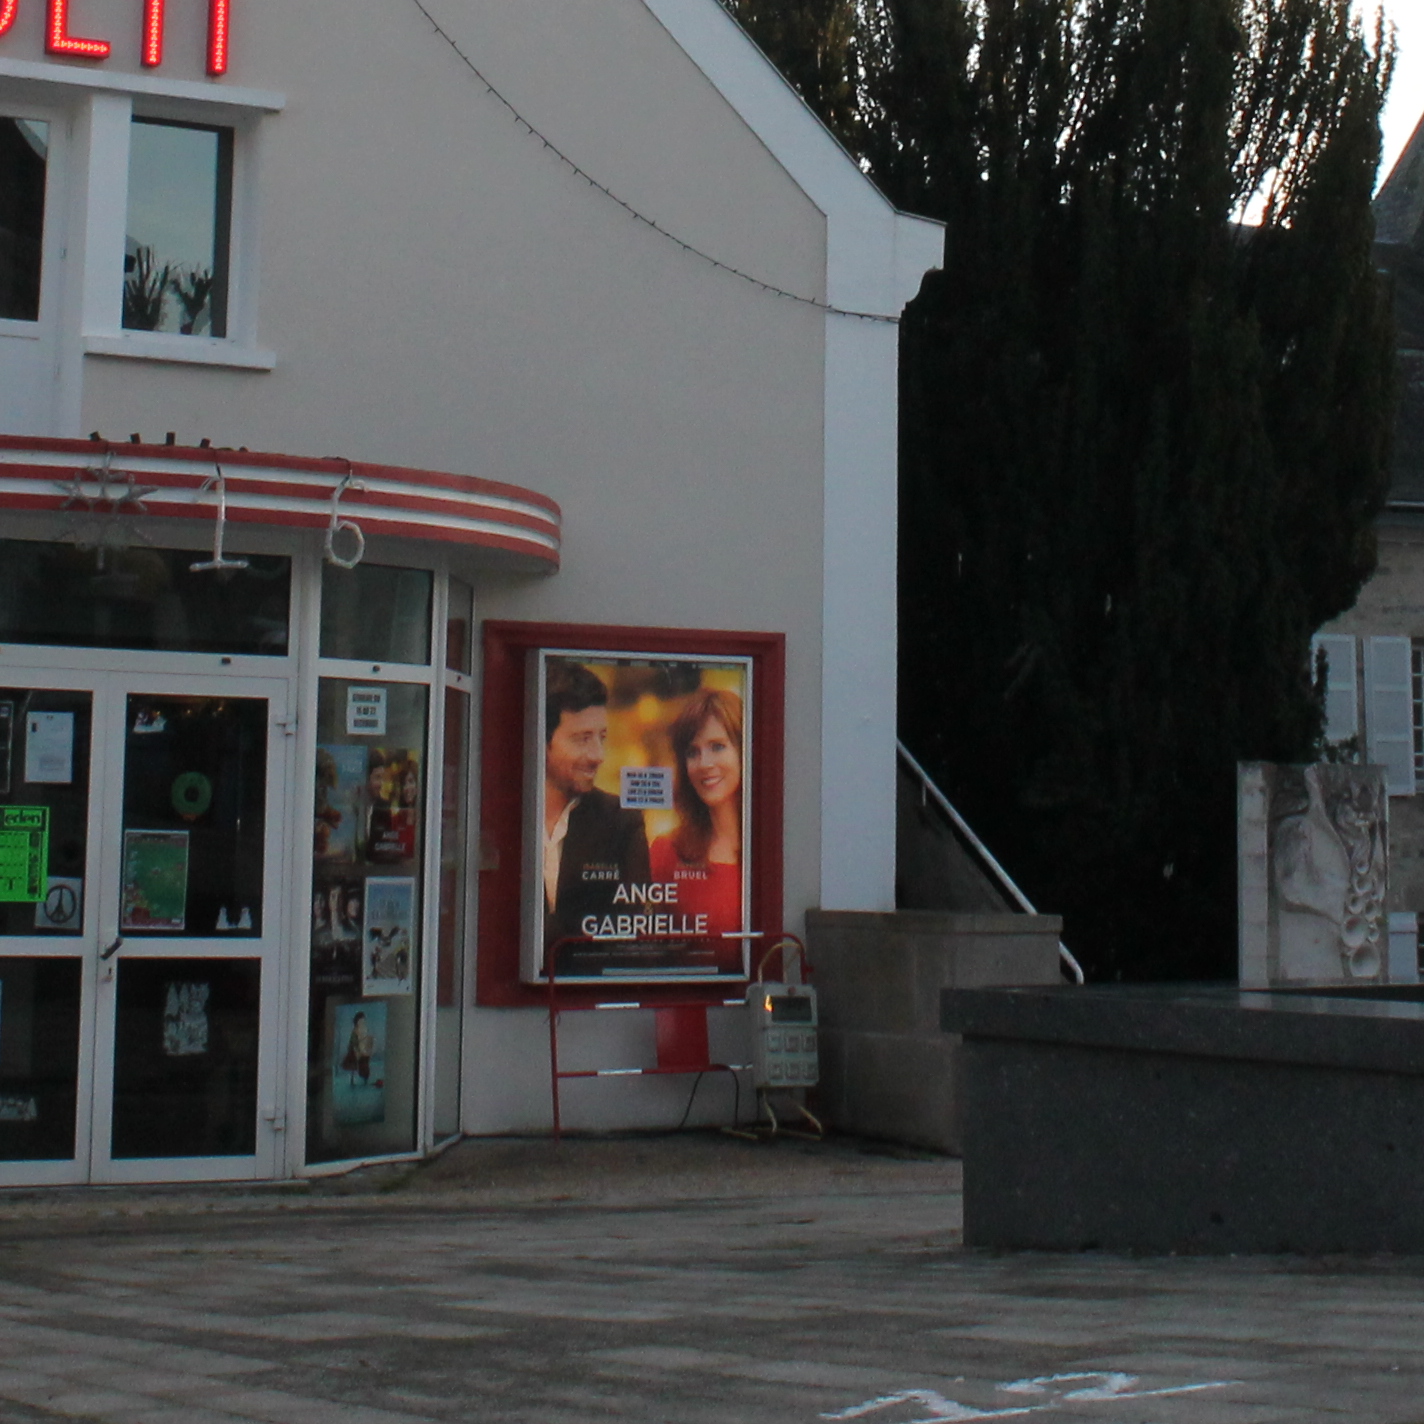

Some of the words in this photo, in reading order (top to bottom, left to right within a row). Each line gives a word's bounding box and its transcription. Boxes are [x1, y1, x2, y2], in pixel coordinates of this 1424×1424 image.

[5, 809, 41, 826] eden
[673, 870, 708, 880] BRUEL
[613, 883, 678, 904] ANGE
[581, 914, 708, 935] GABRIELLE
